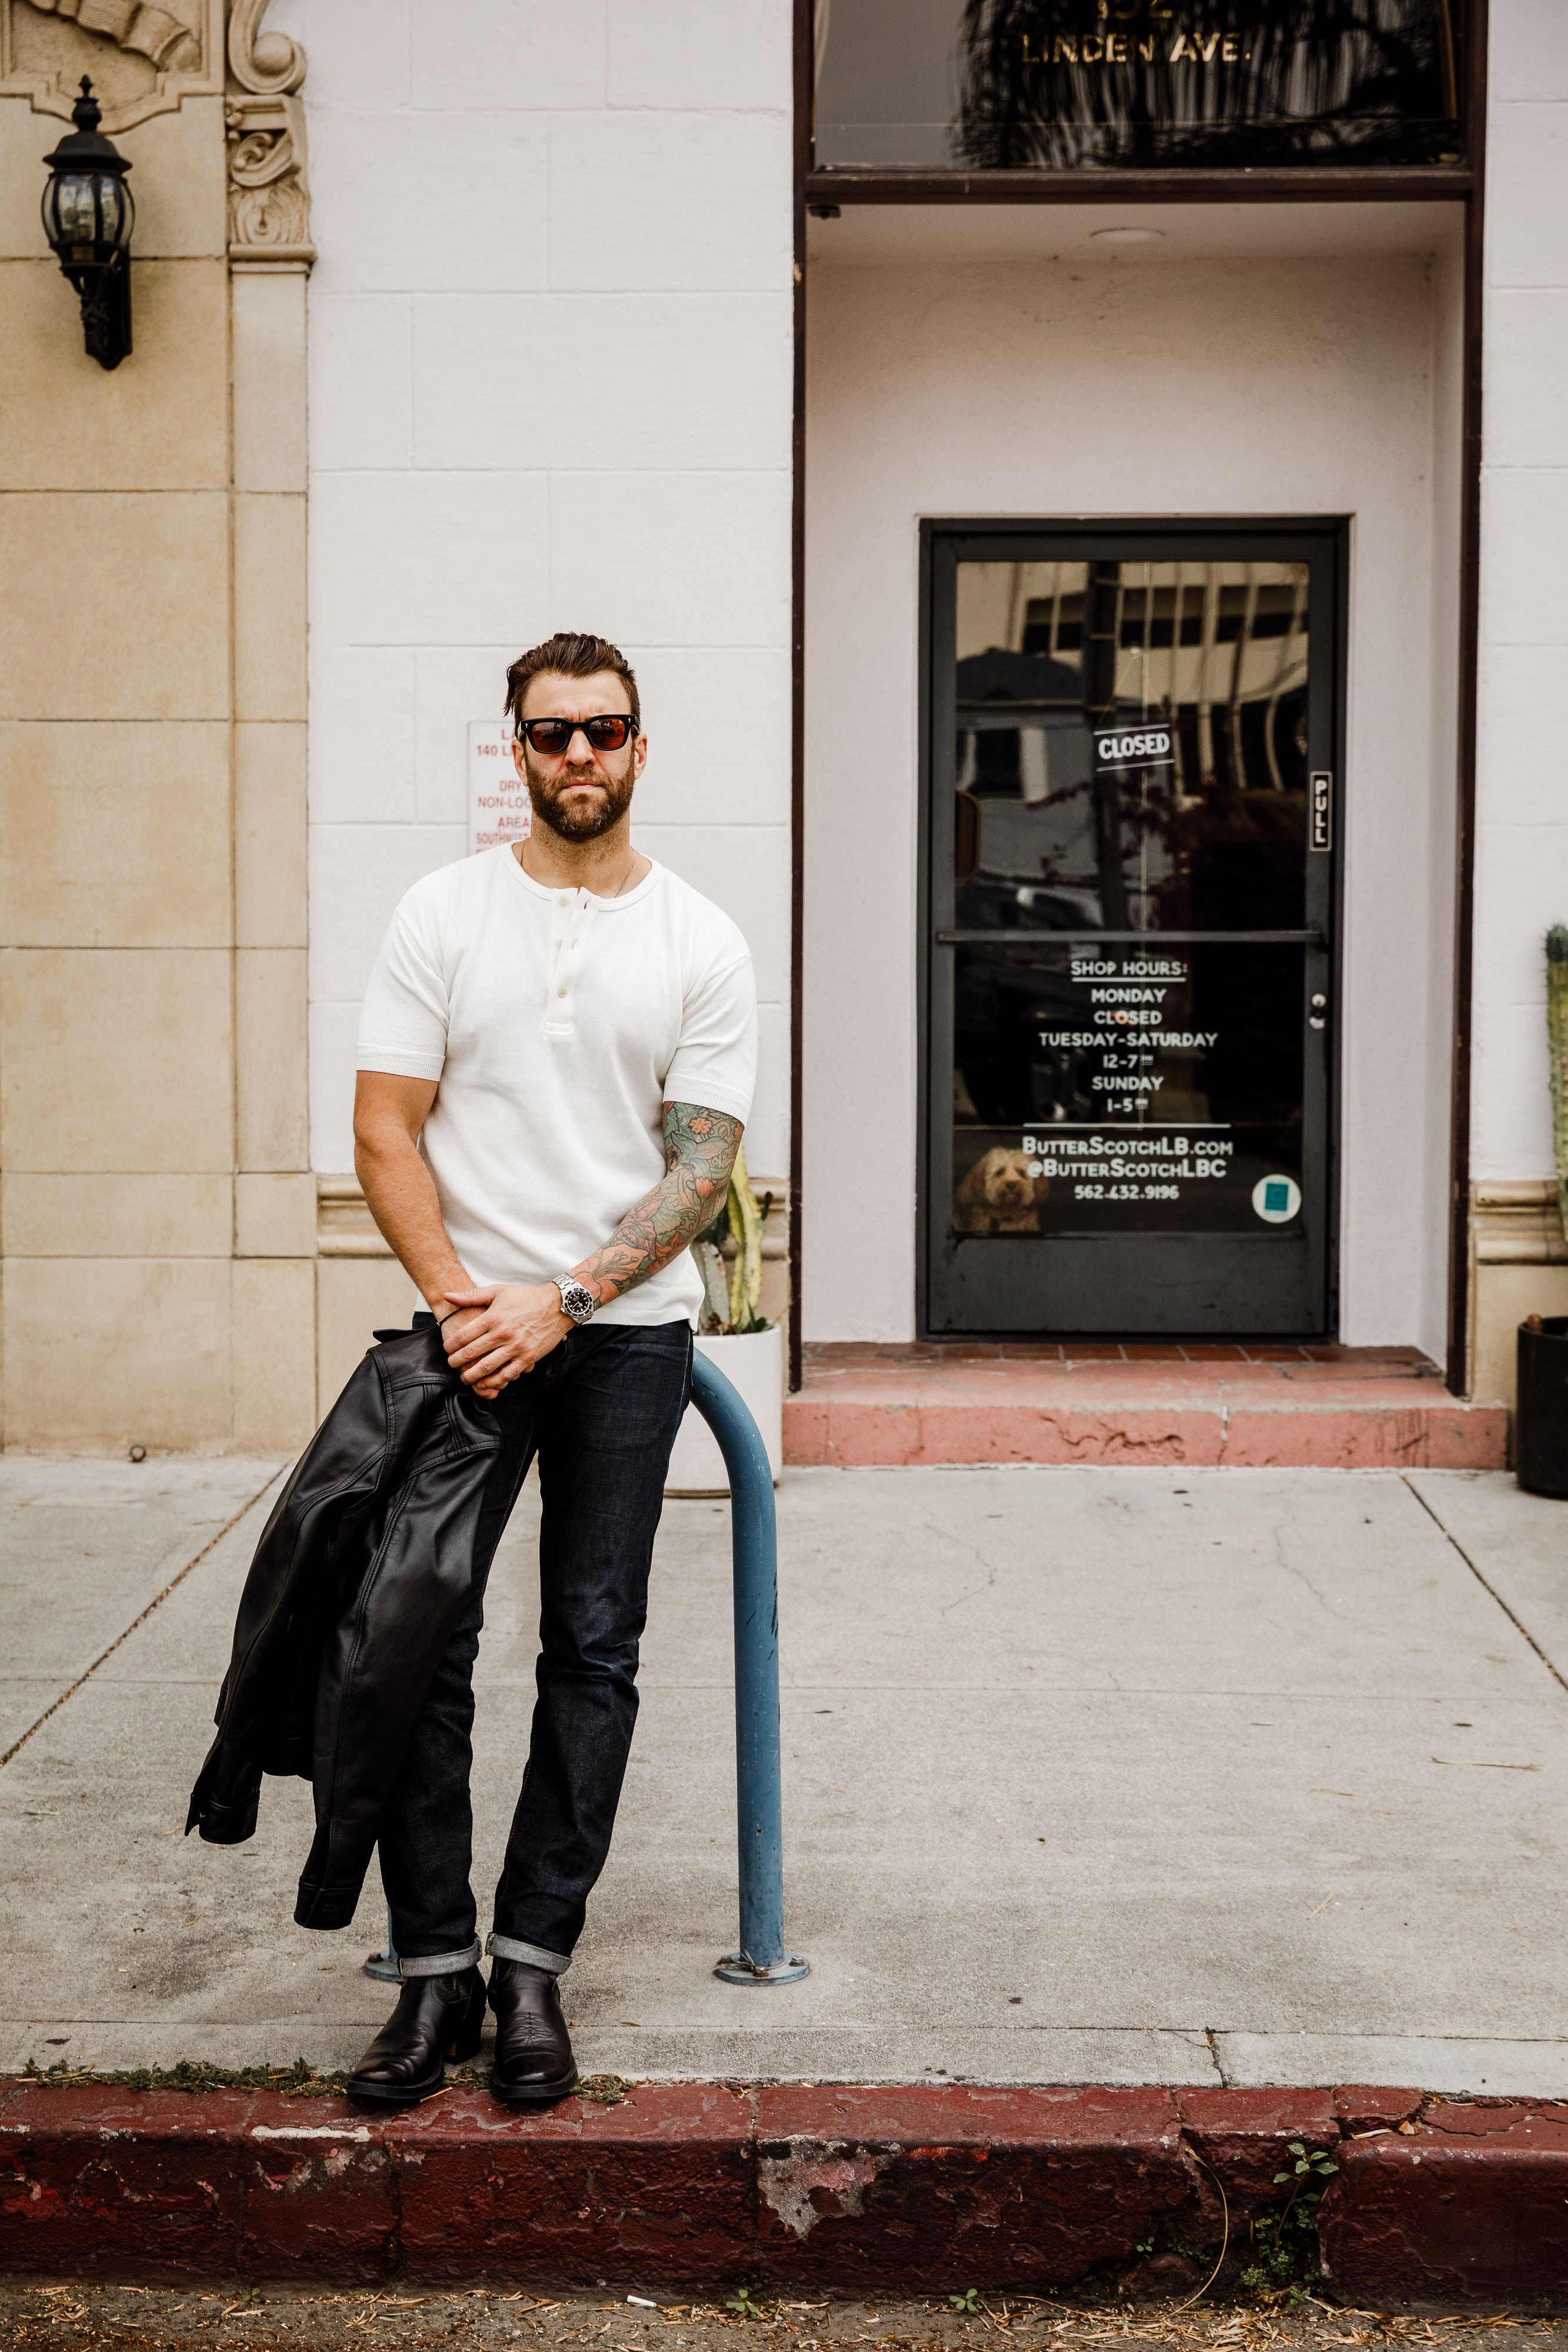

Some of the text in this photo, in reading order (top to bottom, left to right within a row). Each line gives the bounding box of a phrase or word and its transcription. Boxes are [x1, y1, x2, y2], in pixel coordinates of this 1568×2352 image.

[1022, 32, 1251, 62] LINDEN AVE.
[476, 744, 498, 757] 140
[1098, 733, 1171, 760] CLOSED
[499, 780, 521, 792] DRY
[1315, 779, 1328, 843] PULL
[1071, 960, 1188, 975] SHOP HOURS:
[1091, 988, 1167, 1003] MONDAY
[1094, 1010, 1162, 1025] CLOSED
[1039, 1031, 1218, 1047] TUESDAY-SATURDAY
[1092, 1075, 1164, 1091] SUNDAY
[1074, 1184, 1180, 1200] 562.432.9196
